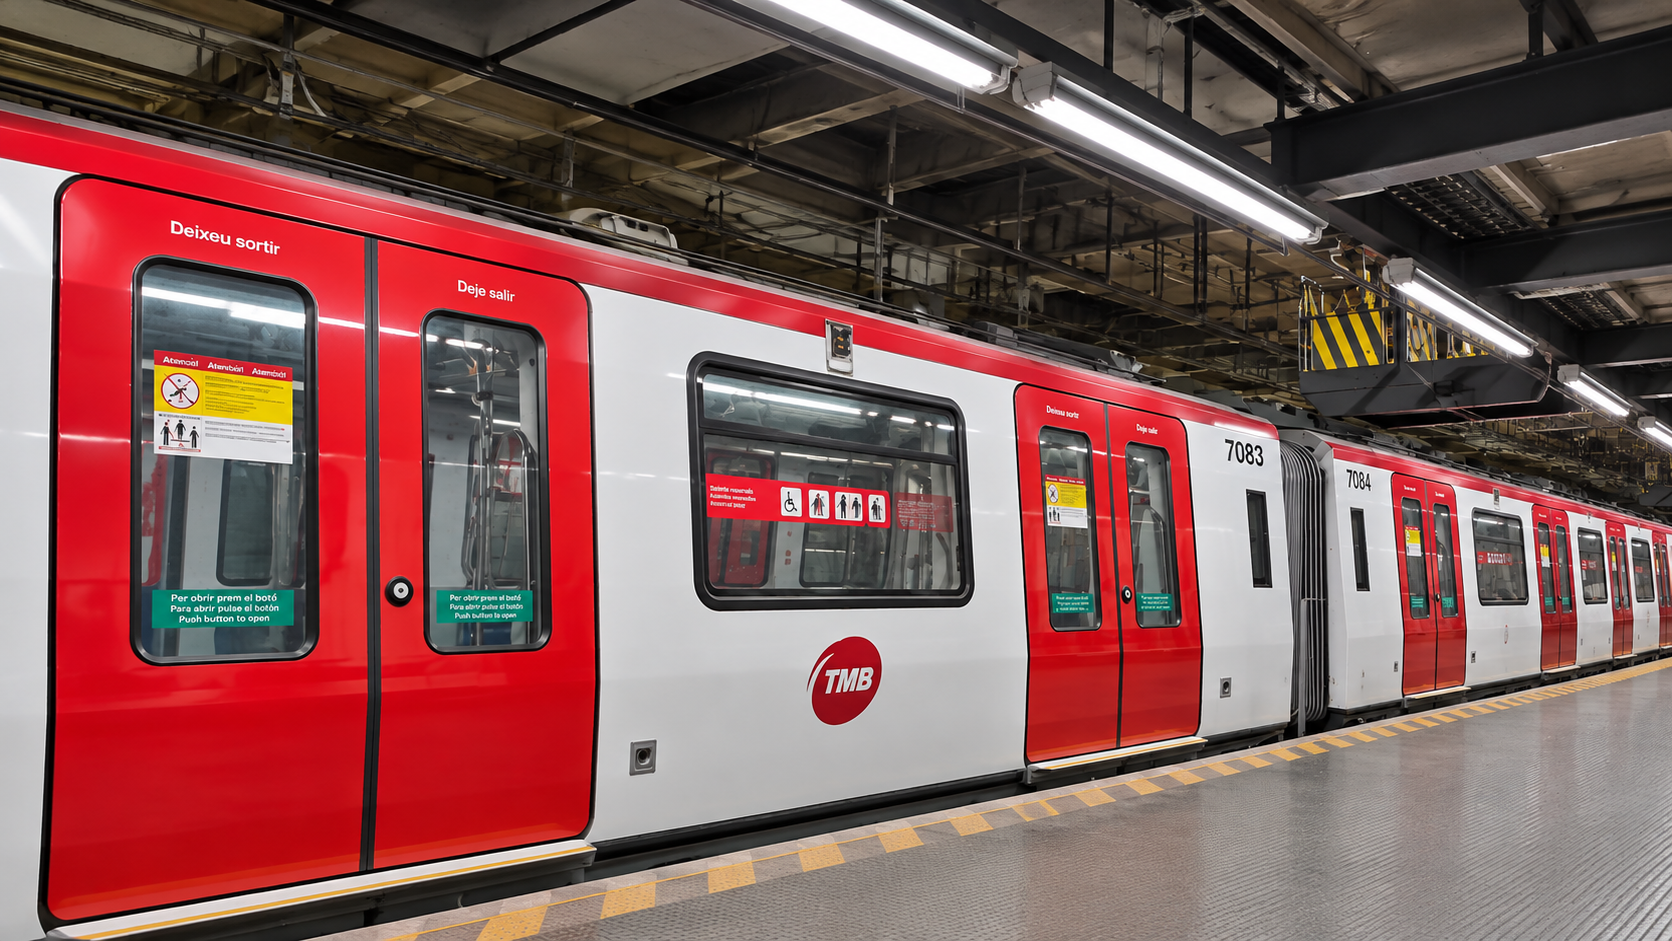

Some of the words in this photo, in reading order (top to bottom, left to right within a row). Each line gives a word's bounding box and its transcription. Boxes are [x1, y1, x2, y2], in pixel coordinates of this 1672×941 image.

[170, 219, 231, 246] Deixeu
[235, 236, 280, 255] sortir
[457, 279, 486, 298] Deje
[489, 289, 515, 302] salir
[1225, 438, 1264, 467] 7083
[1346, 468, 1372, 491] 7084
[170, 604, 191, 613] Para
[193, 604, 215, 613] abrir
[244, 603, 253, 612] el
[254, 603, 280, 612] botón
[171, 594, 188, 602] Per
[190, 593, 214, 602] obrir
[217, 594, 242, 604] prem
[244, 594, 253, 602] el
[255, 593, 277, 602] botó
[204, 615, 234, 623] button
[236, 615, 246, 623] to
[248, 615, 270, 623] open
[825, 666, 874, 695] TMB
